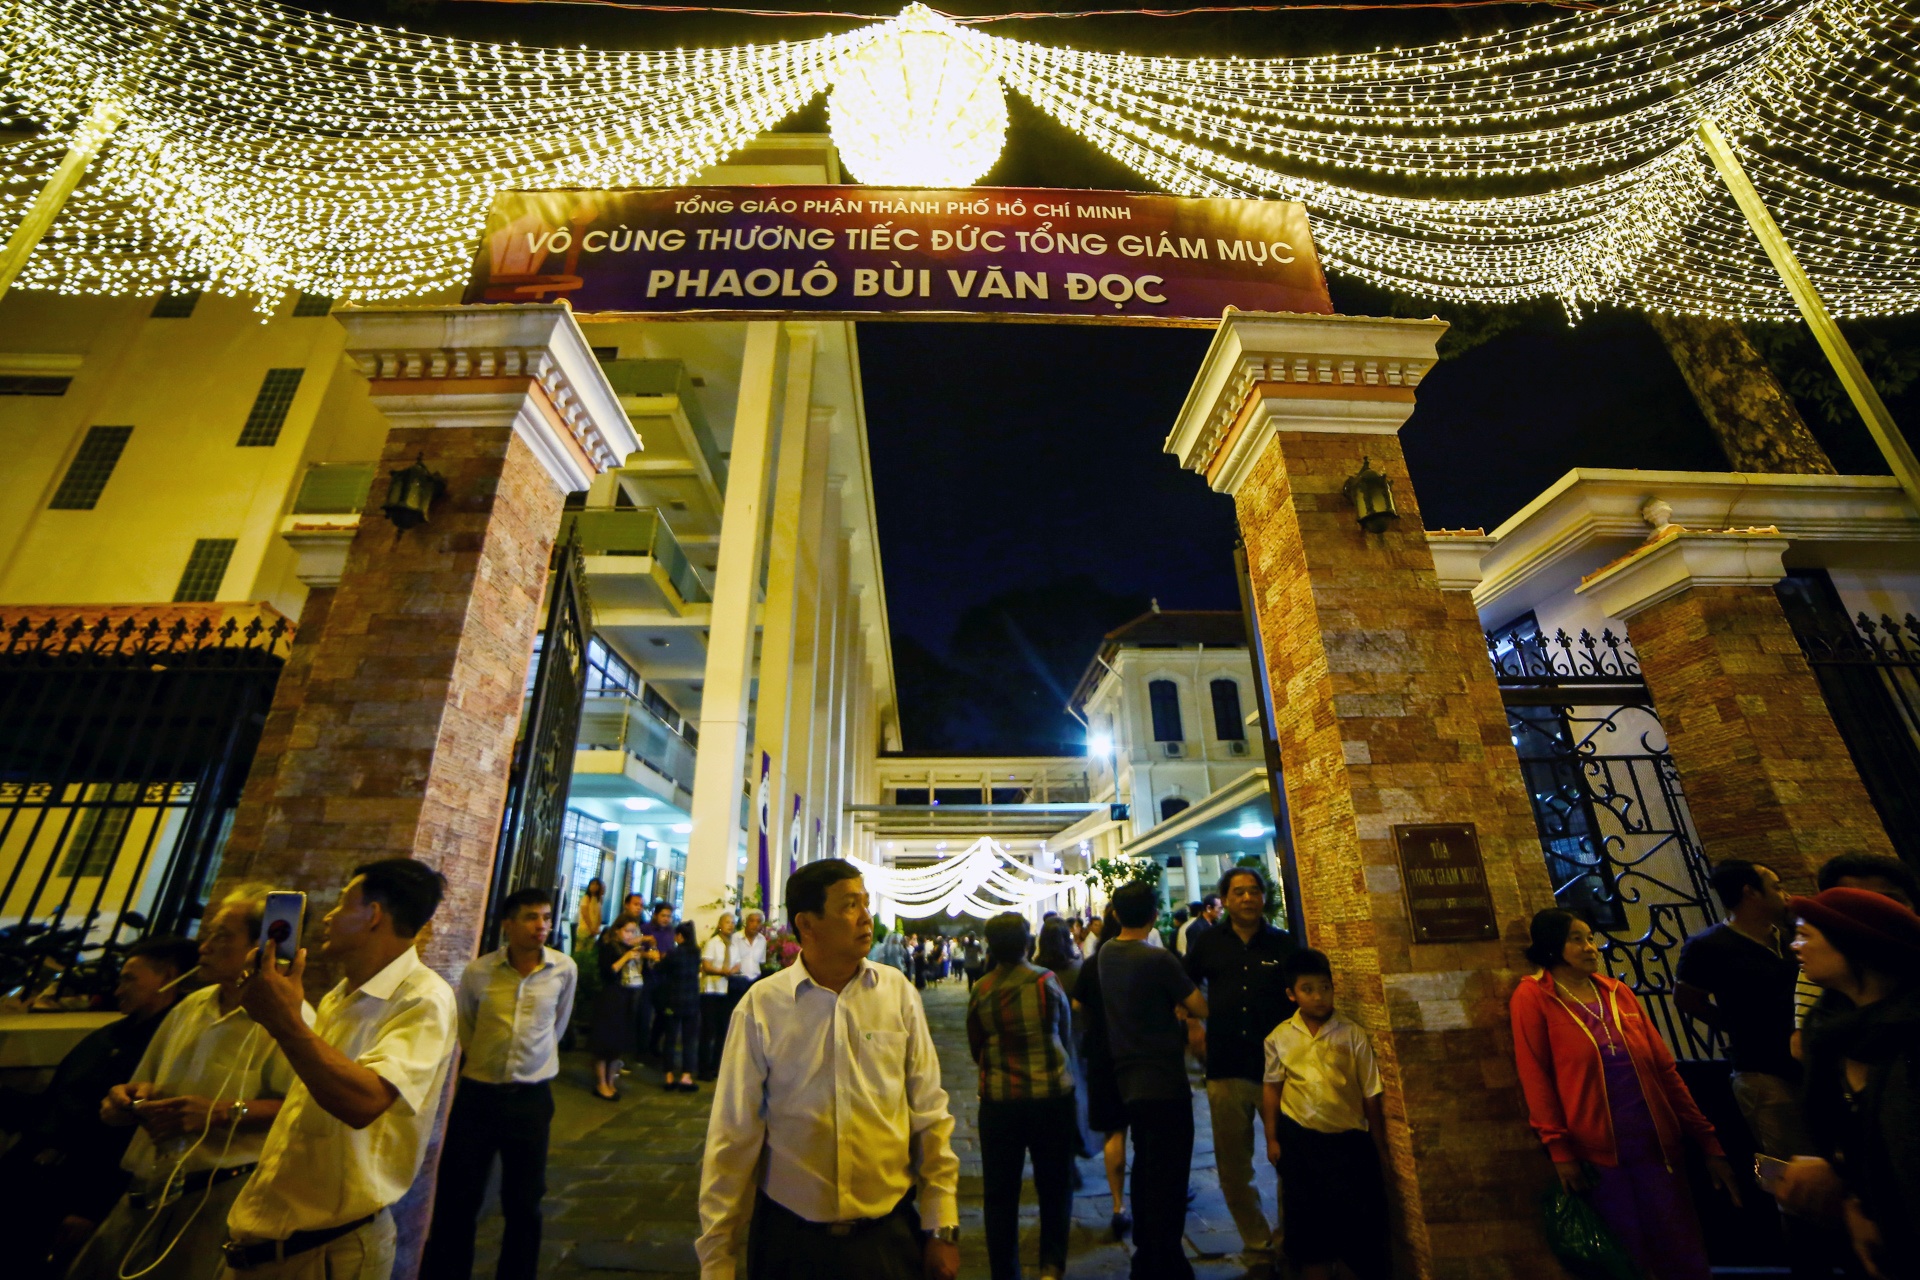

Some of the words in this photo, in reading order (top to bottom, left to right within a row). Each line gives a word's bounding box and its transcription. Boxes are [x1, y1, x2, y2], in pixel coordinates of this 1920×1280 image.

[675, 194, 734, 214] TỔNG
[740, 197, 797, 214] GIÁO
[803, 198, 862, 215] PHẬN
[869, 198, 940, 214] THÀNH
[947, 198, 990, 216] PHỐ
[996, 198, 1027, 216] HỒ
[1033, 202, 1070, 218] CHÍ
[1077, 205, 1132, 219] MINH
[527, 226, 571, 254] VÔ
[582, 223, 686, 252] CÙNG
[697, 225, 835, 251] THƯƠNG
[845, 221, 920, 251] TIẾC
[930, 224, 1006, 252] ĐỨC
[1015, 221, 1108, 256] TỔNG
[1117, 230, 1209, 260] GIÁM
[1217, 238, 1296, 267] MỤC
[646, 260, 838, 298] PHAOLÔ
[853, 260, 930, 298] BÙI
[947, 265, 1049, 300] VĂN
[1063, 271, 1167, 309] ĐỌC
